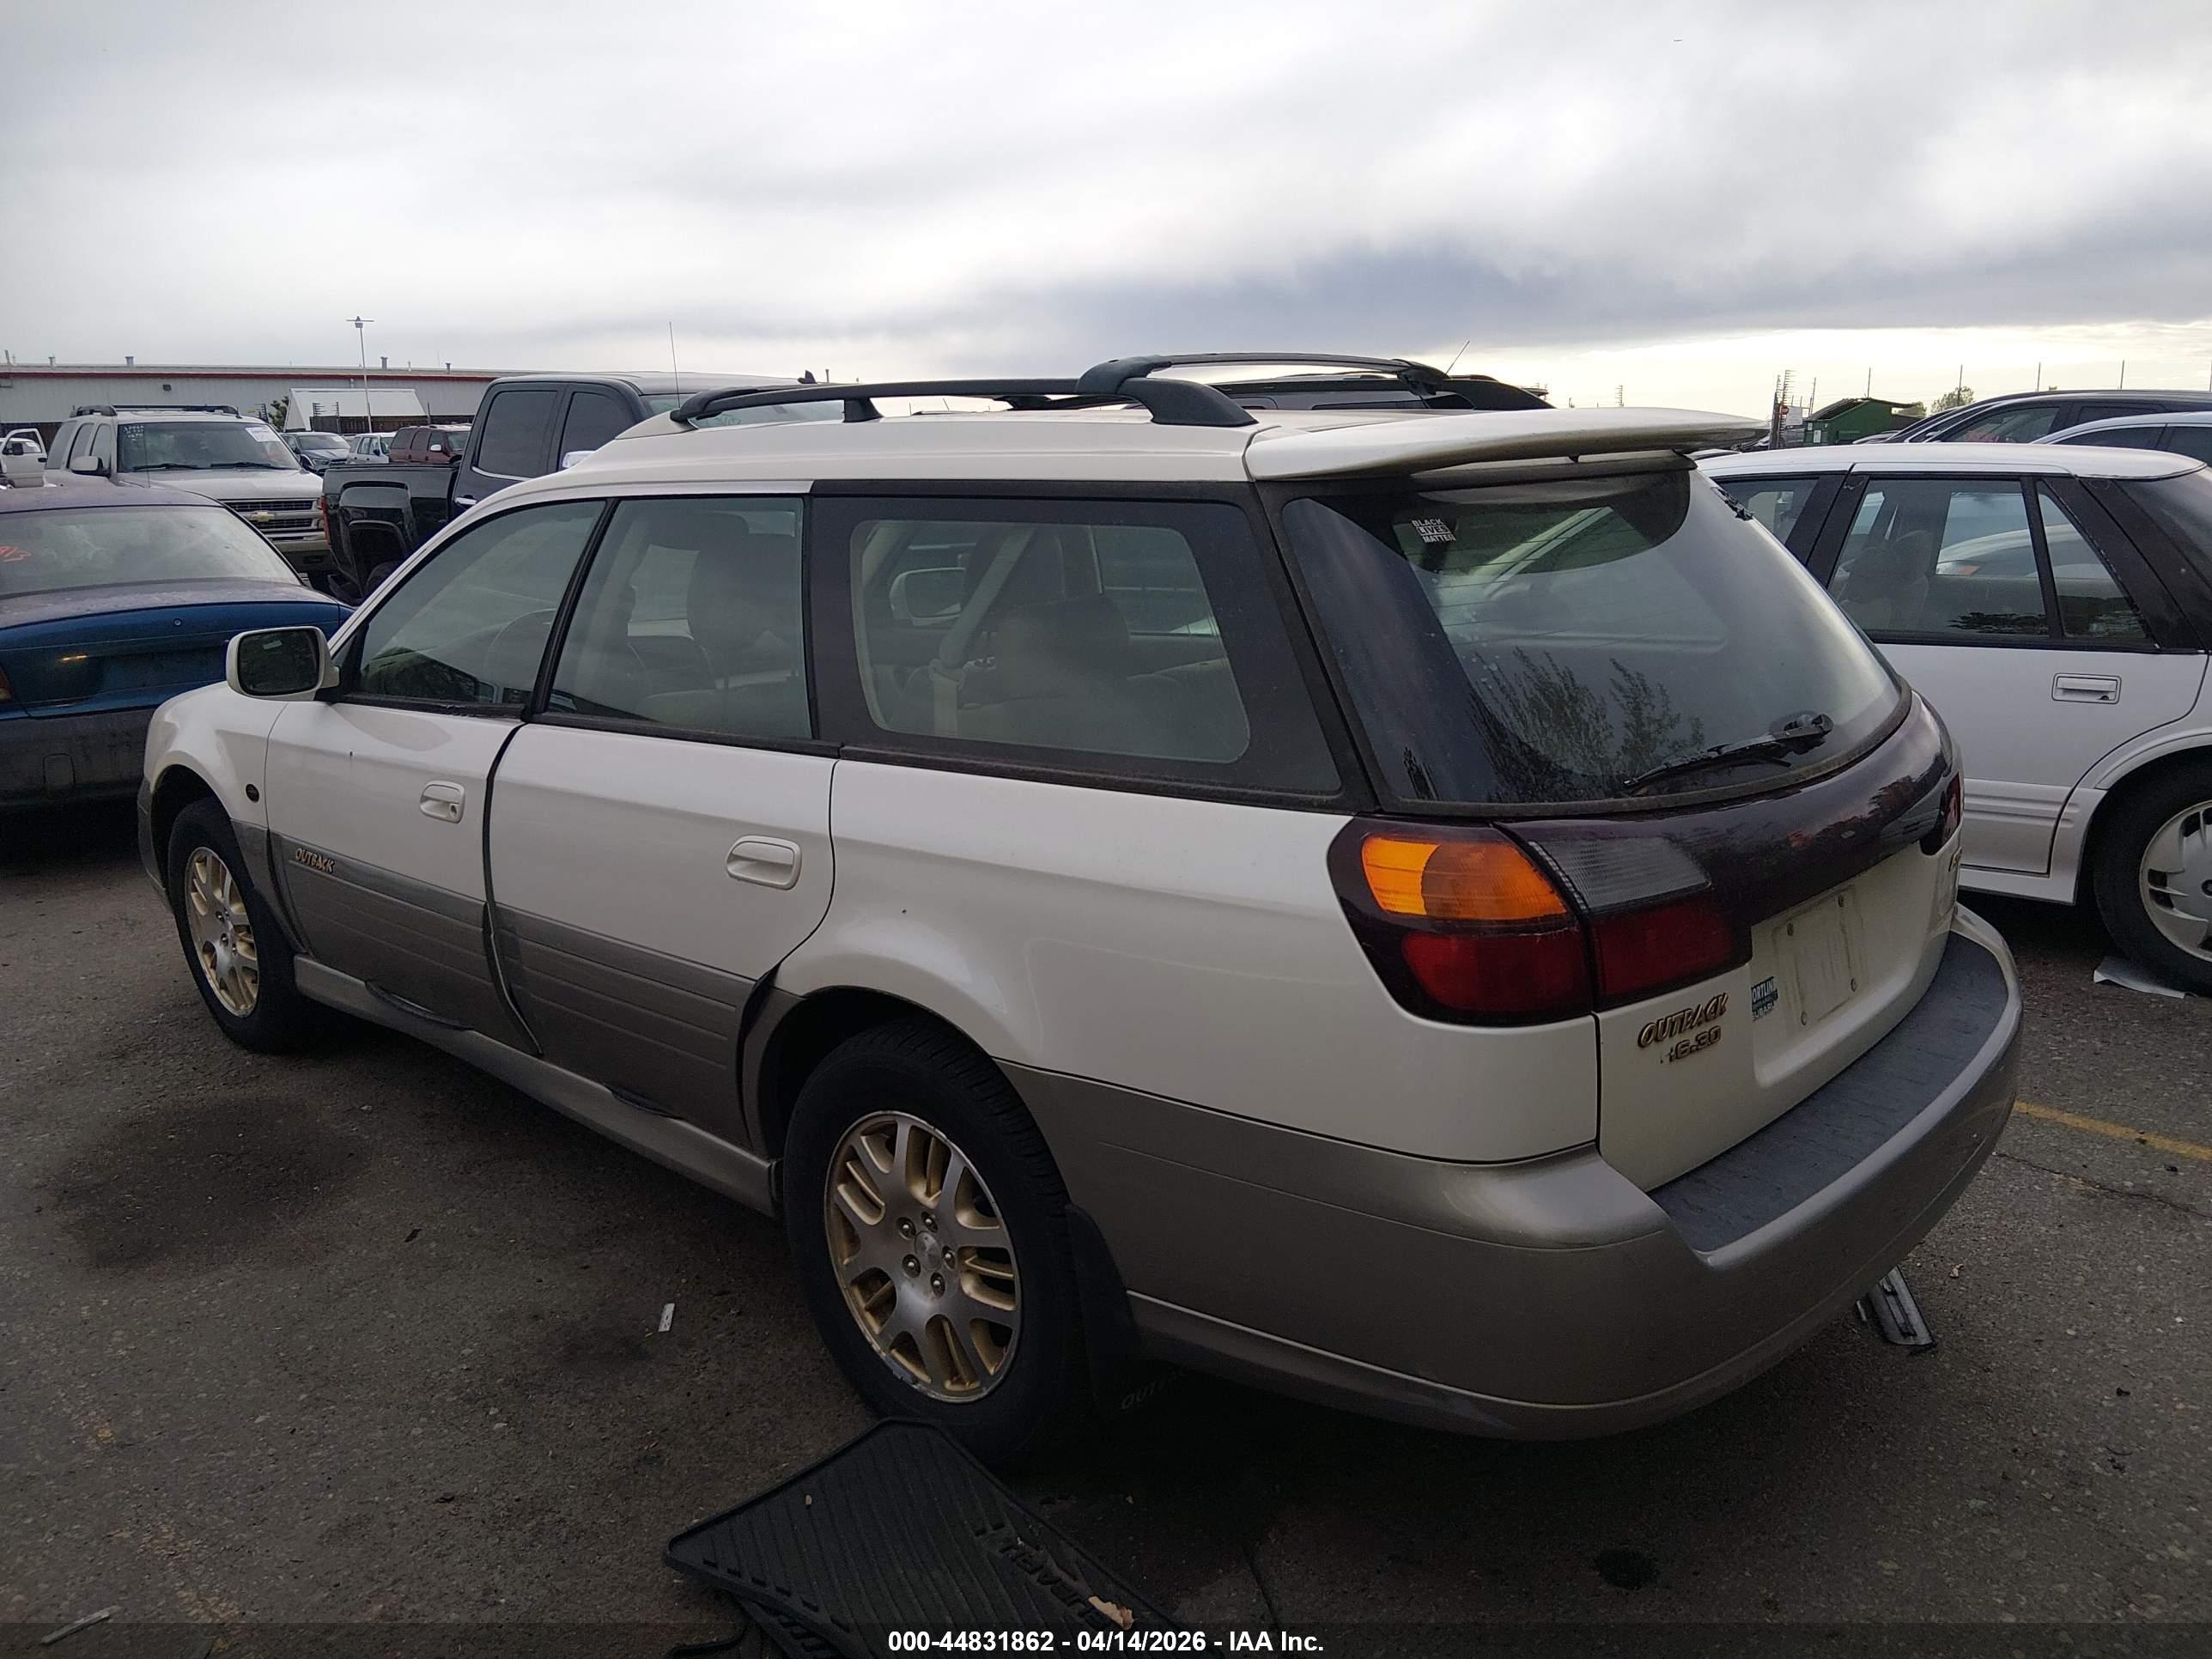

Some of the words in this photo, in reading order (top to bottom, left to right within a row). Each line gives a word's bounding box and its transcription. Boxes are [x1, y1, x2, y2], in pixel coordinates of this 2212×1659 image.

[1417, 526, 1451, 535] LIVES
[295, 848, 336, 874] OUTBACK
[1638, 993, 1729, 1048] OUTBACK
